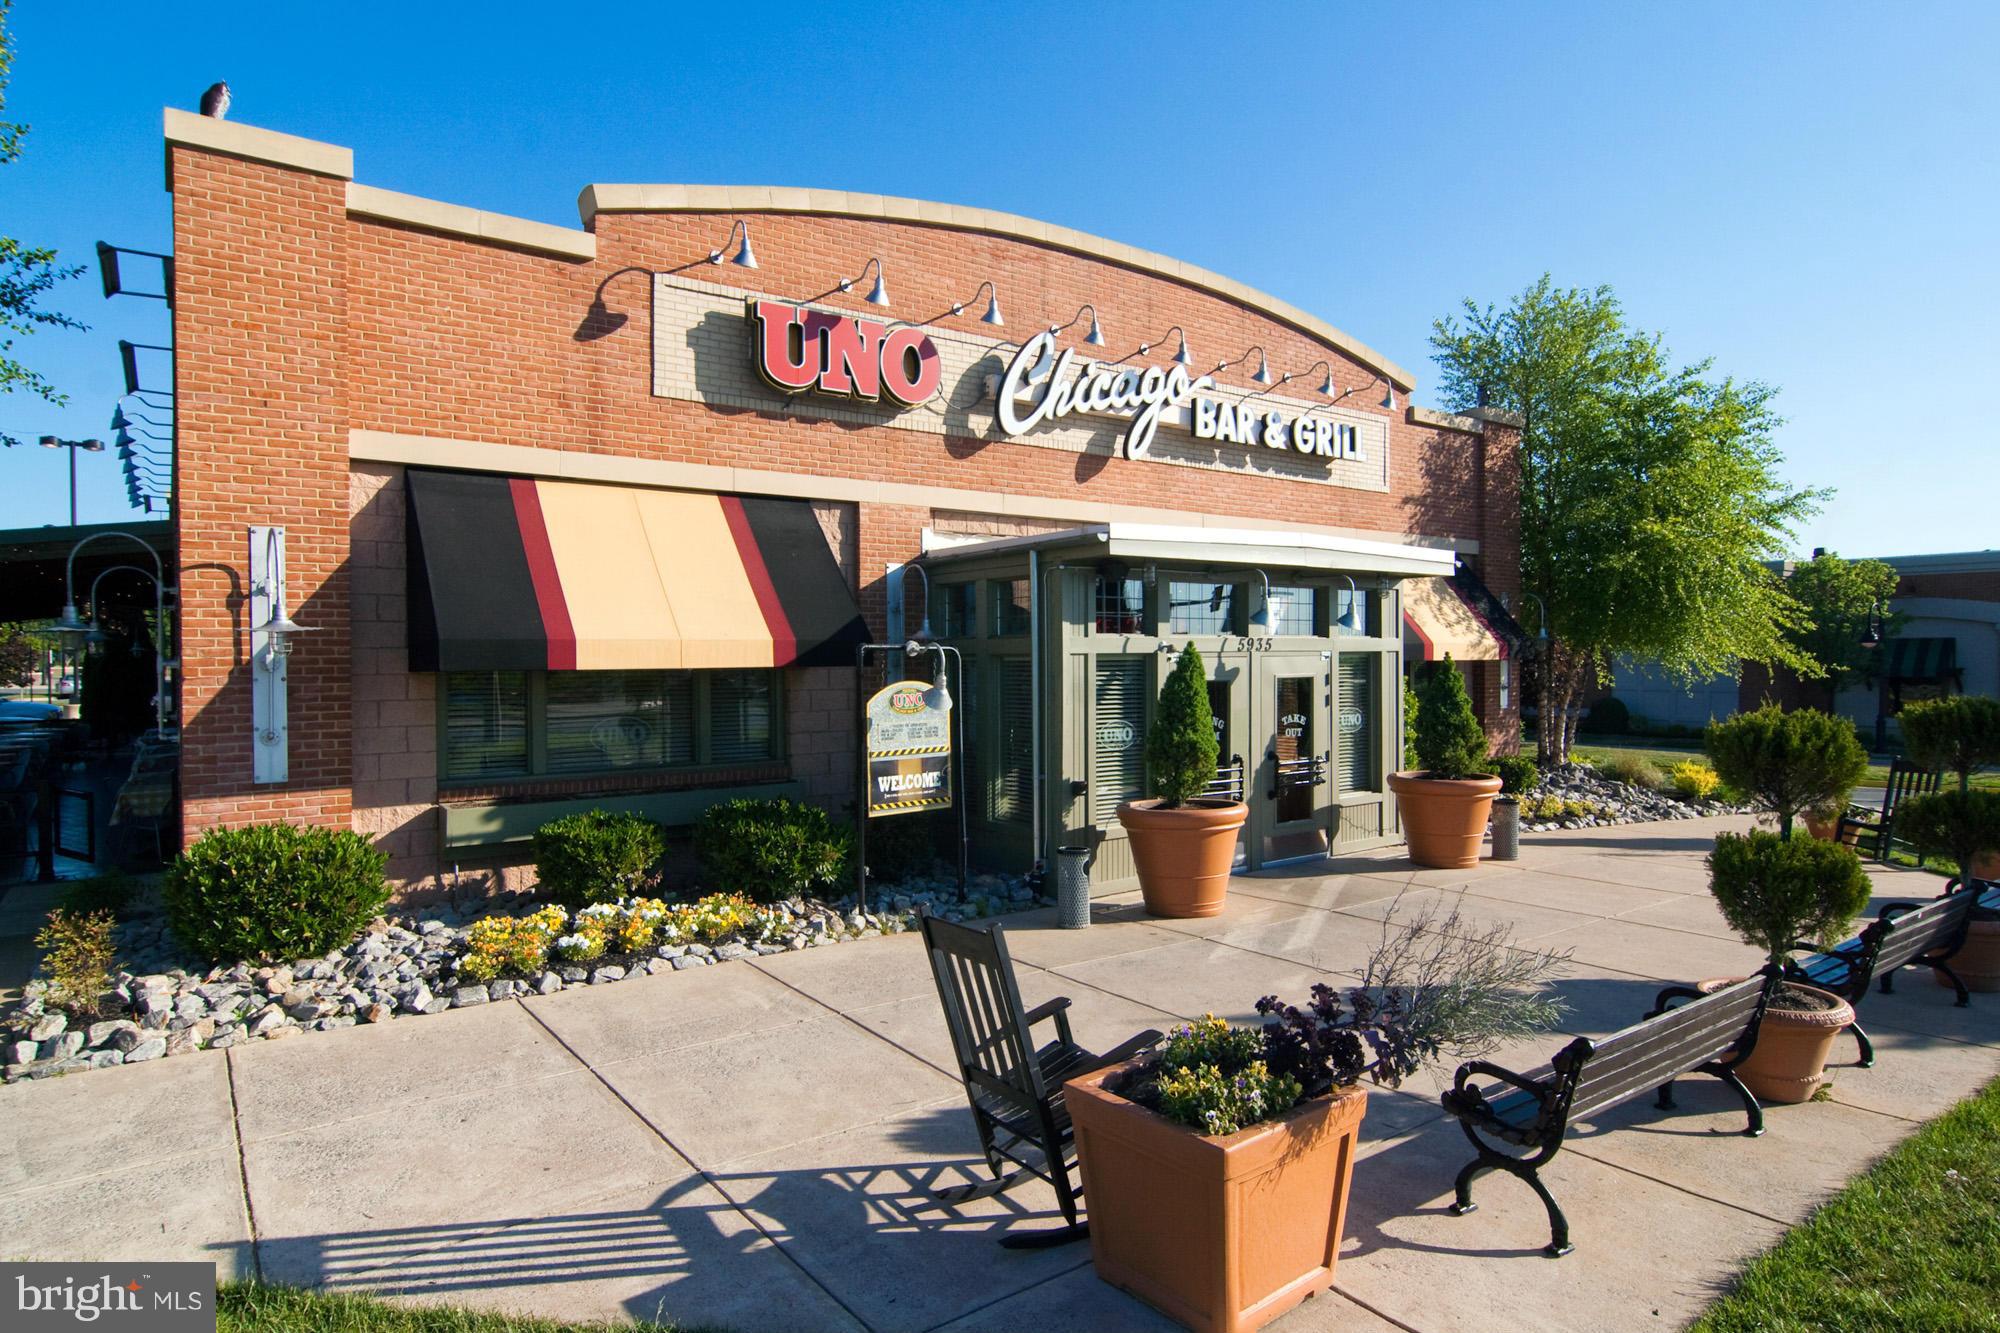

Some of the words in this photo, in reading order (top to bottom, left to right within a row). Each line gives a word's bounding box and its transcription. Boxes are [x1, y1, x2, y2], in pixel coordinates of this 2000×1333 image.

[754, 299, 942, 405] UNO
[997, 330, 1216, 462] Chicago
[1193, 398, 1256, 446] BAR
[1262, 411, 1288, 450] &
[1292, 415, 1368, 462] GRILL
[1237, 637, 1273, 652] 5935
[893, 692, 925, 707] UNO
[1281, 713, 1307, 726] TAKE
[1285, 727, 1303, 738] OUT
[878, 771, 941, 793] WELCOME
